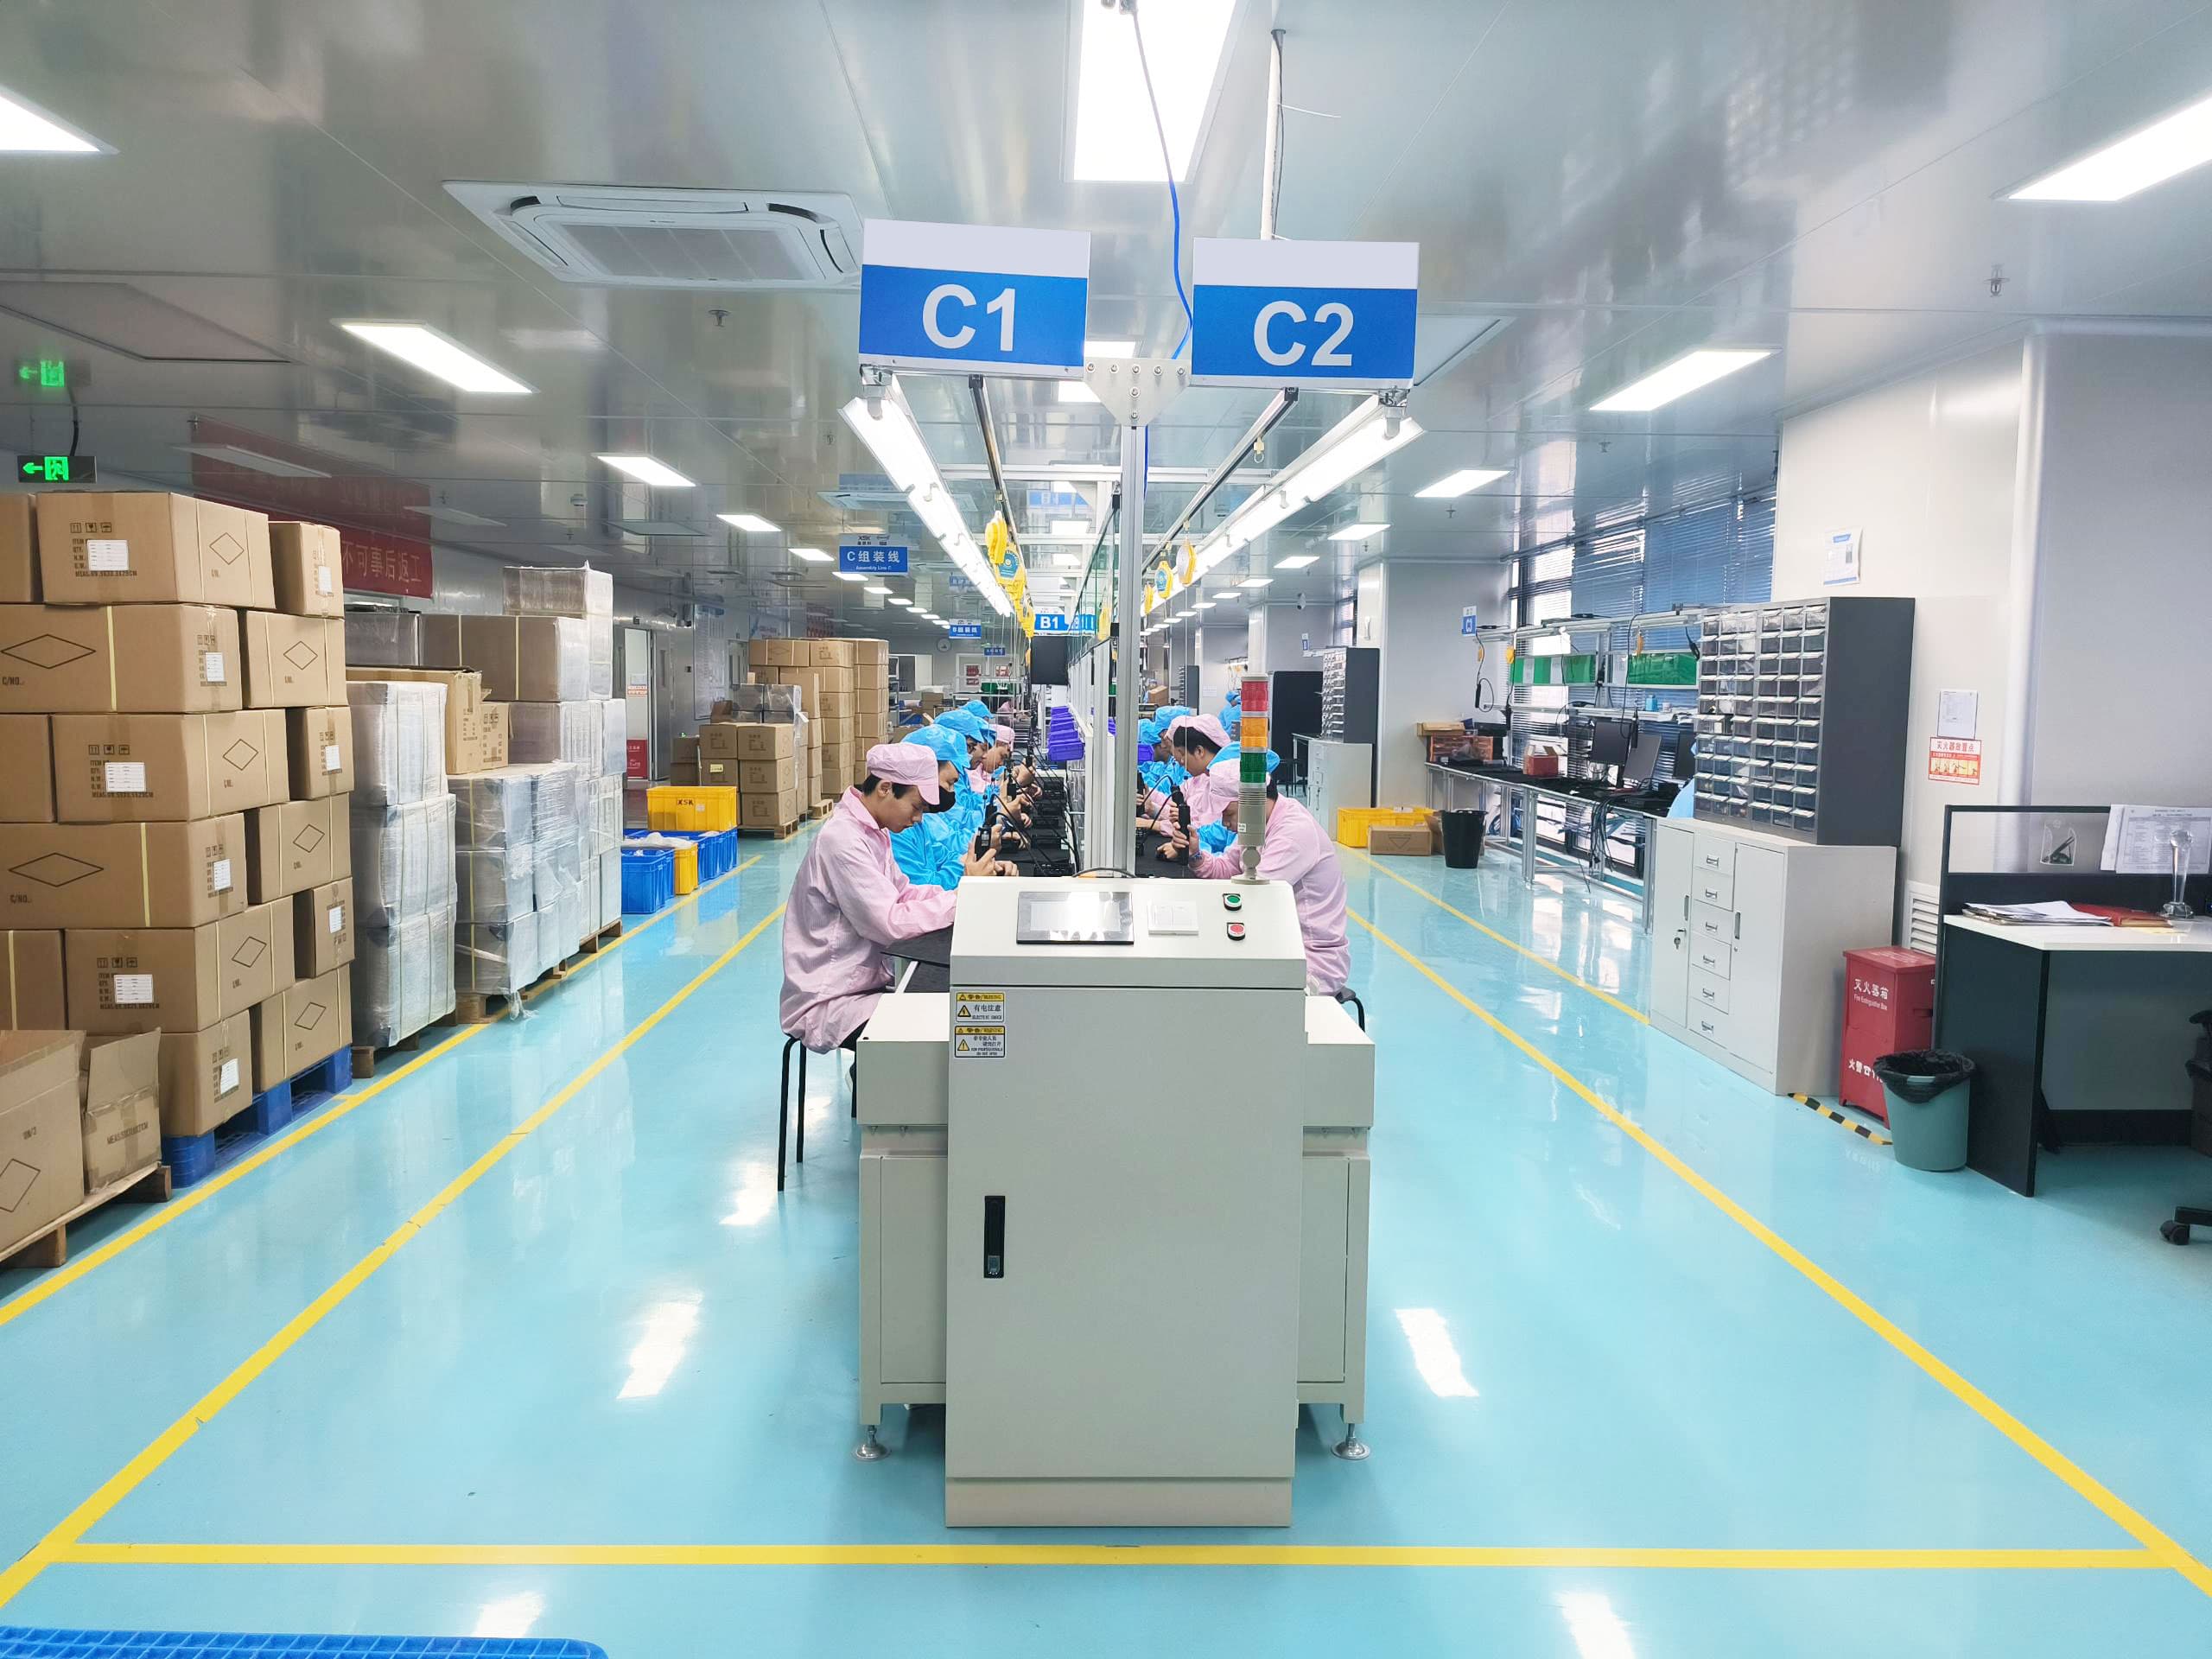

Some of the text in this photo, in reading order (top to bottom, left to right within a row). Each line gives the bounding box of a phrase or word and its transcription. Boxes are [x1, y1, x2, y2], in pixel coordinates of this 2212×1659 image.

[921, 283, 1016, 353] C1
[1253, 300, 1355, 367] C2
[1039, 616, 1058, 629] B1
[1853, 978, 1889, 1000] 灭火器箱
